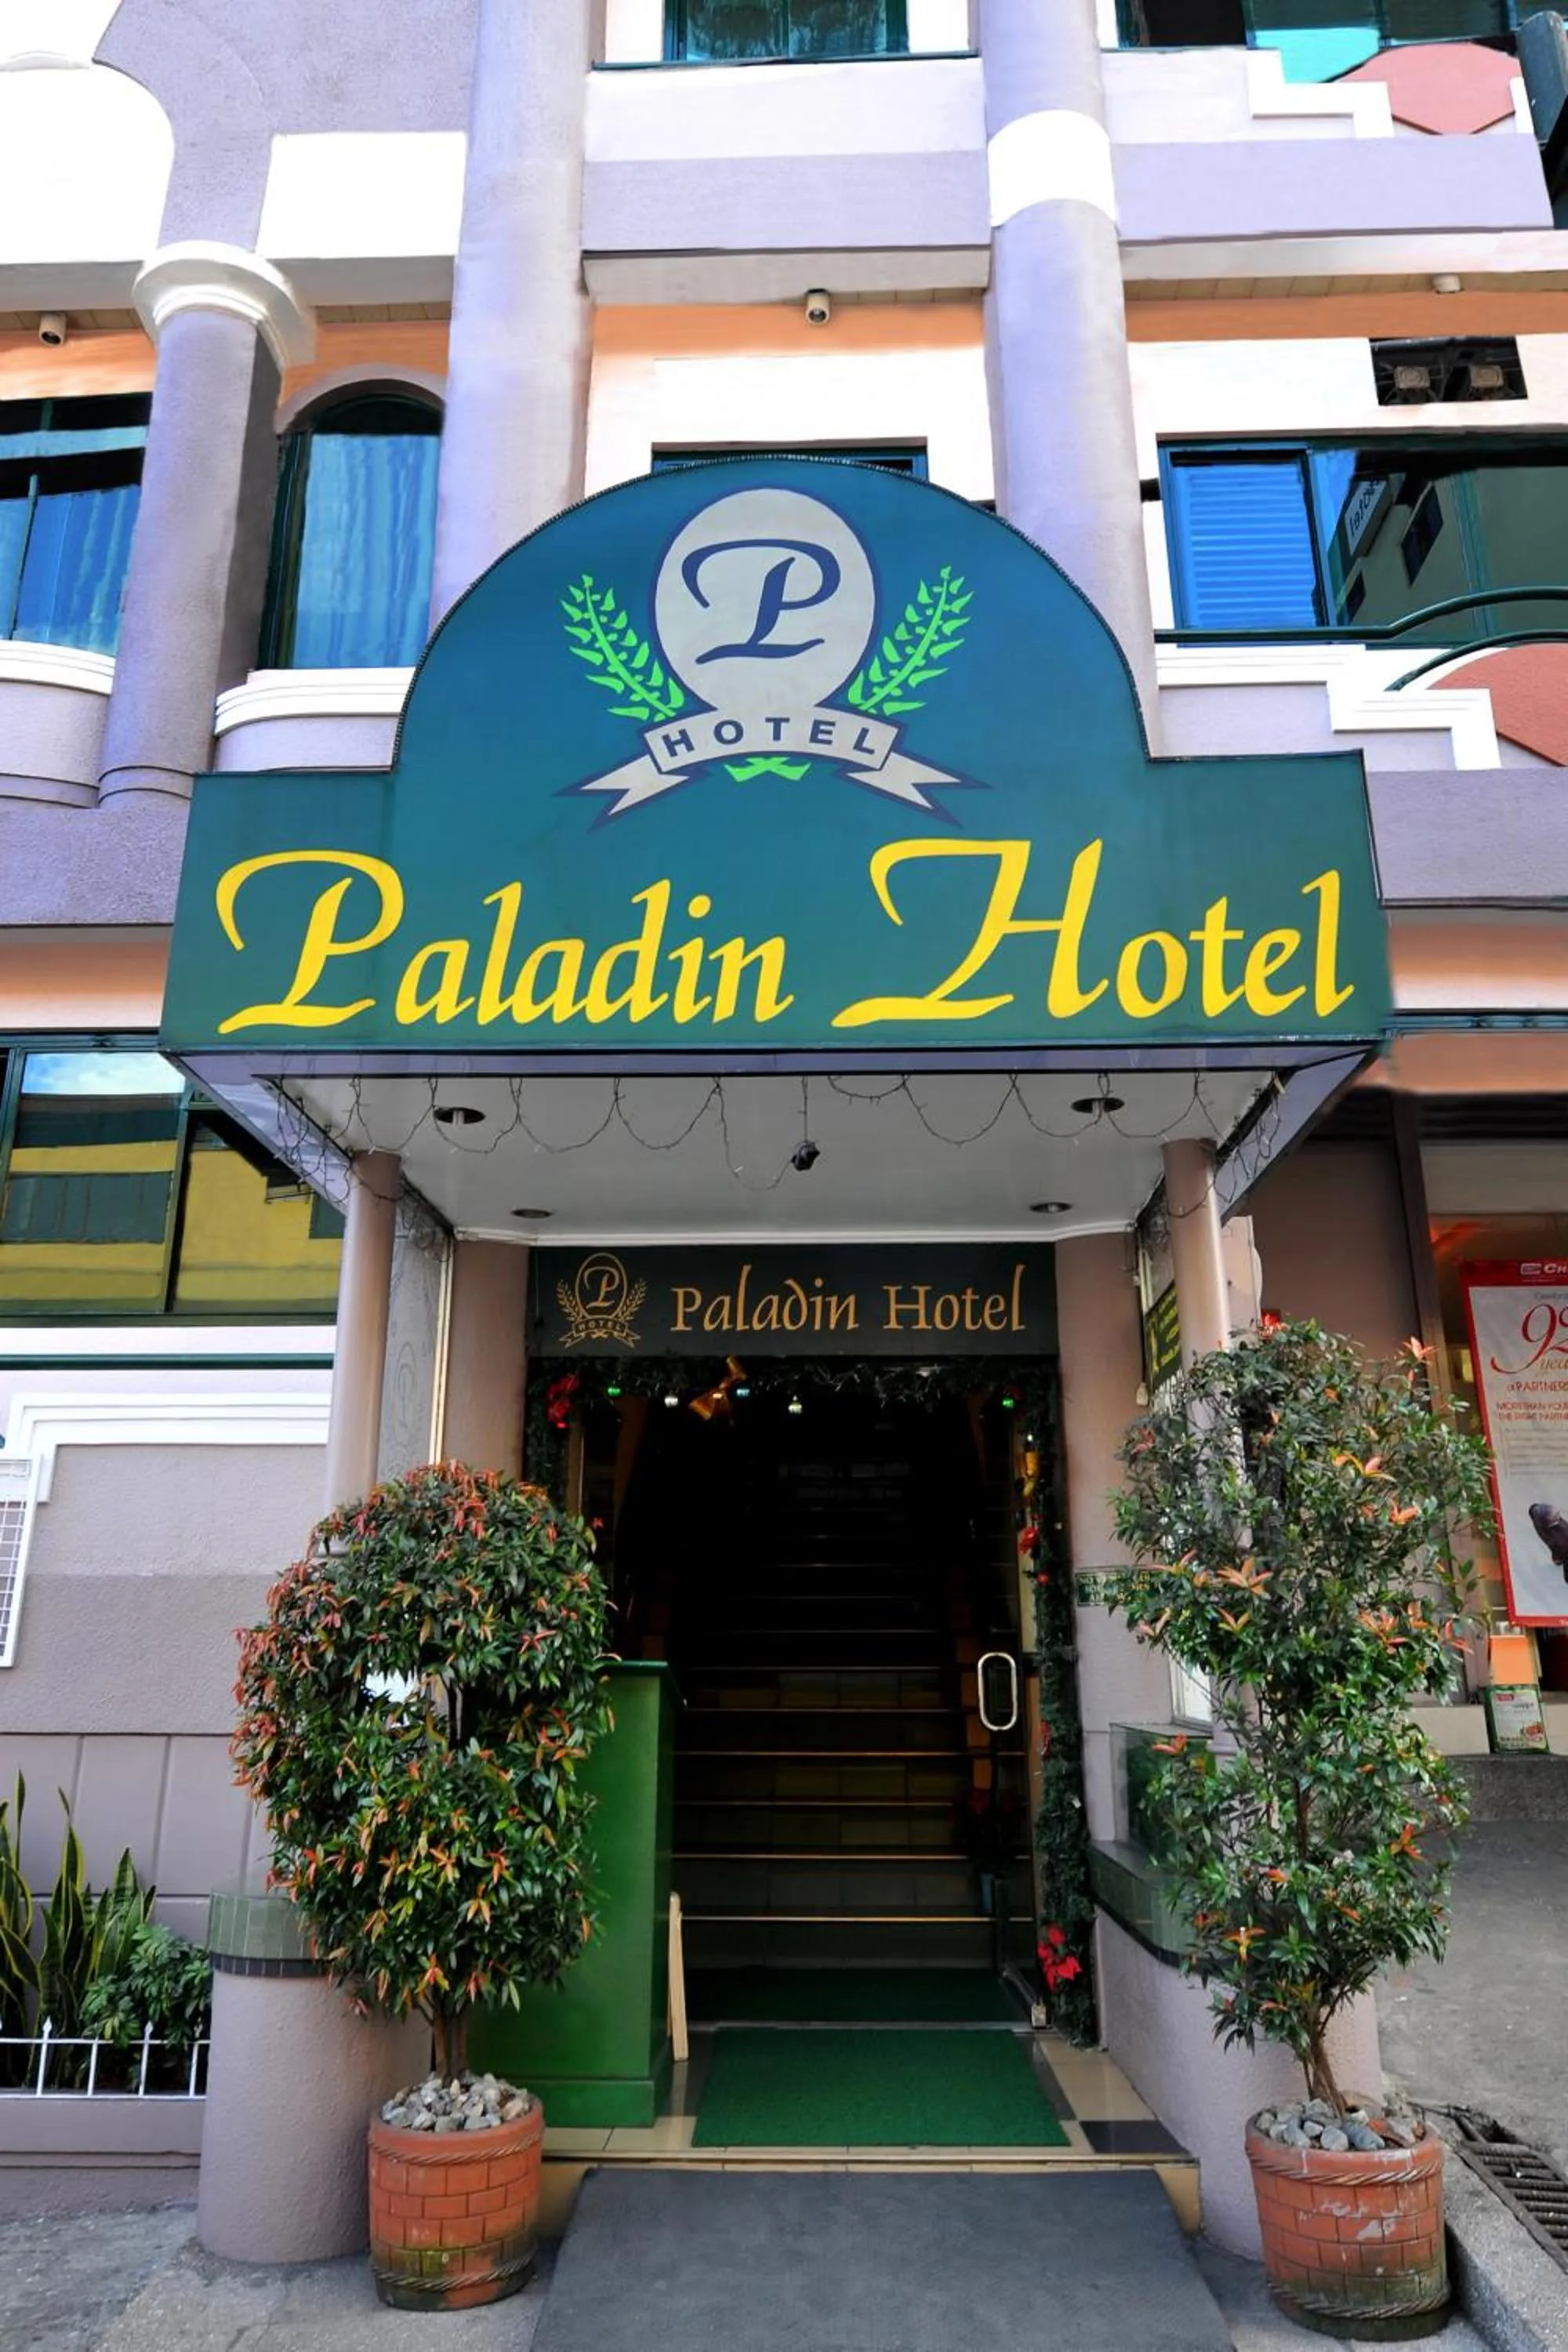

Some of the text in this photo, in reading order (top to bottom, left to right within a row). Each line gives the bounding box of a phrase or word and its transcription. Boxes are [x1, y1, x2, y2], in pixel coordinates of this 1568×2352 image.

[681, 539, 841, 665] P
[662, 717, 876, 757] HOTEL
[216, 838, 1355, 1034] Paladin Hotel
[583, 1266, 620, 1308] P
[670, 1264, 1026, 1331] Paladin Hotel
[578, 1319, 623, 1330] HOTEL
